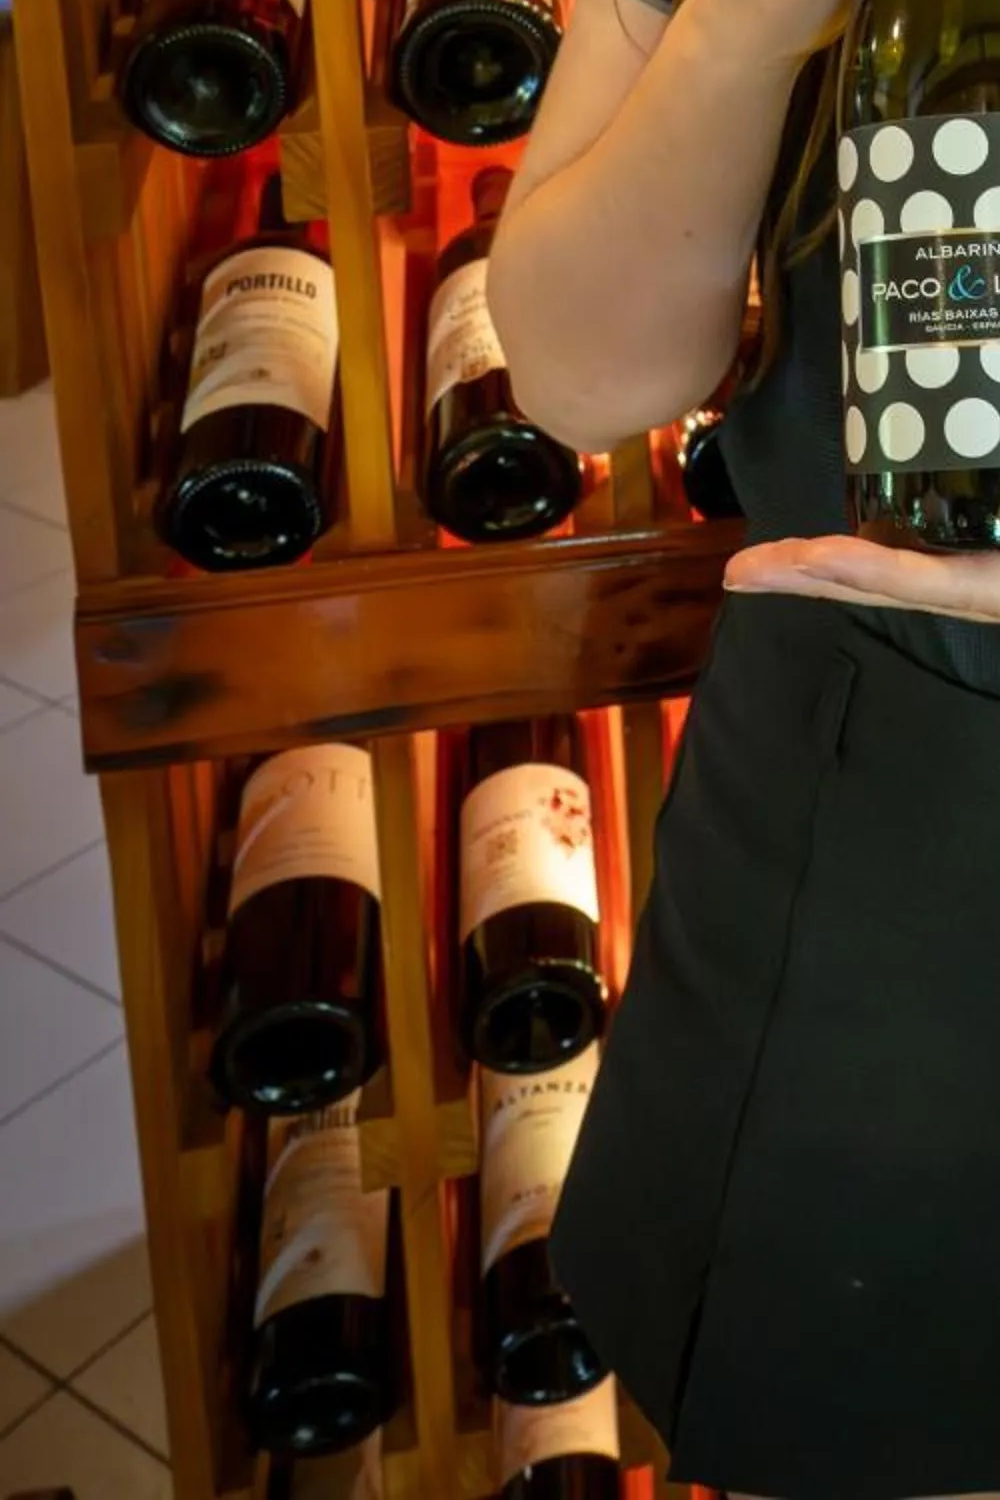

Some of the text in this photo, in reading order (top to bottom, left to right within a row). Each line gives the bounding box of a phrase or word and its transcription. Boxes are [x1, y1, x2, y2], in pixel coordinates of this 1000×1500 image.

[226, 272, 317, 300] PORTILLO
[871, 277, 941, 301] PACO
[948, 264, 986, 301] &
[945, 307, 999, 320] BAIXAS
